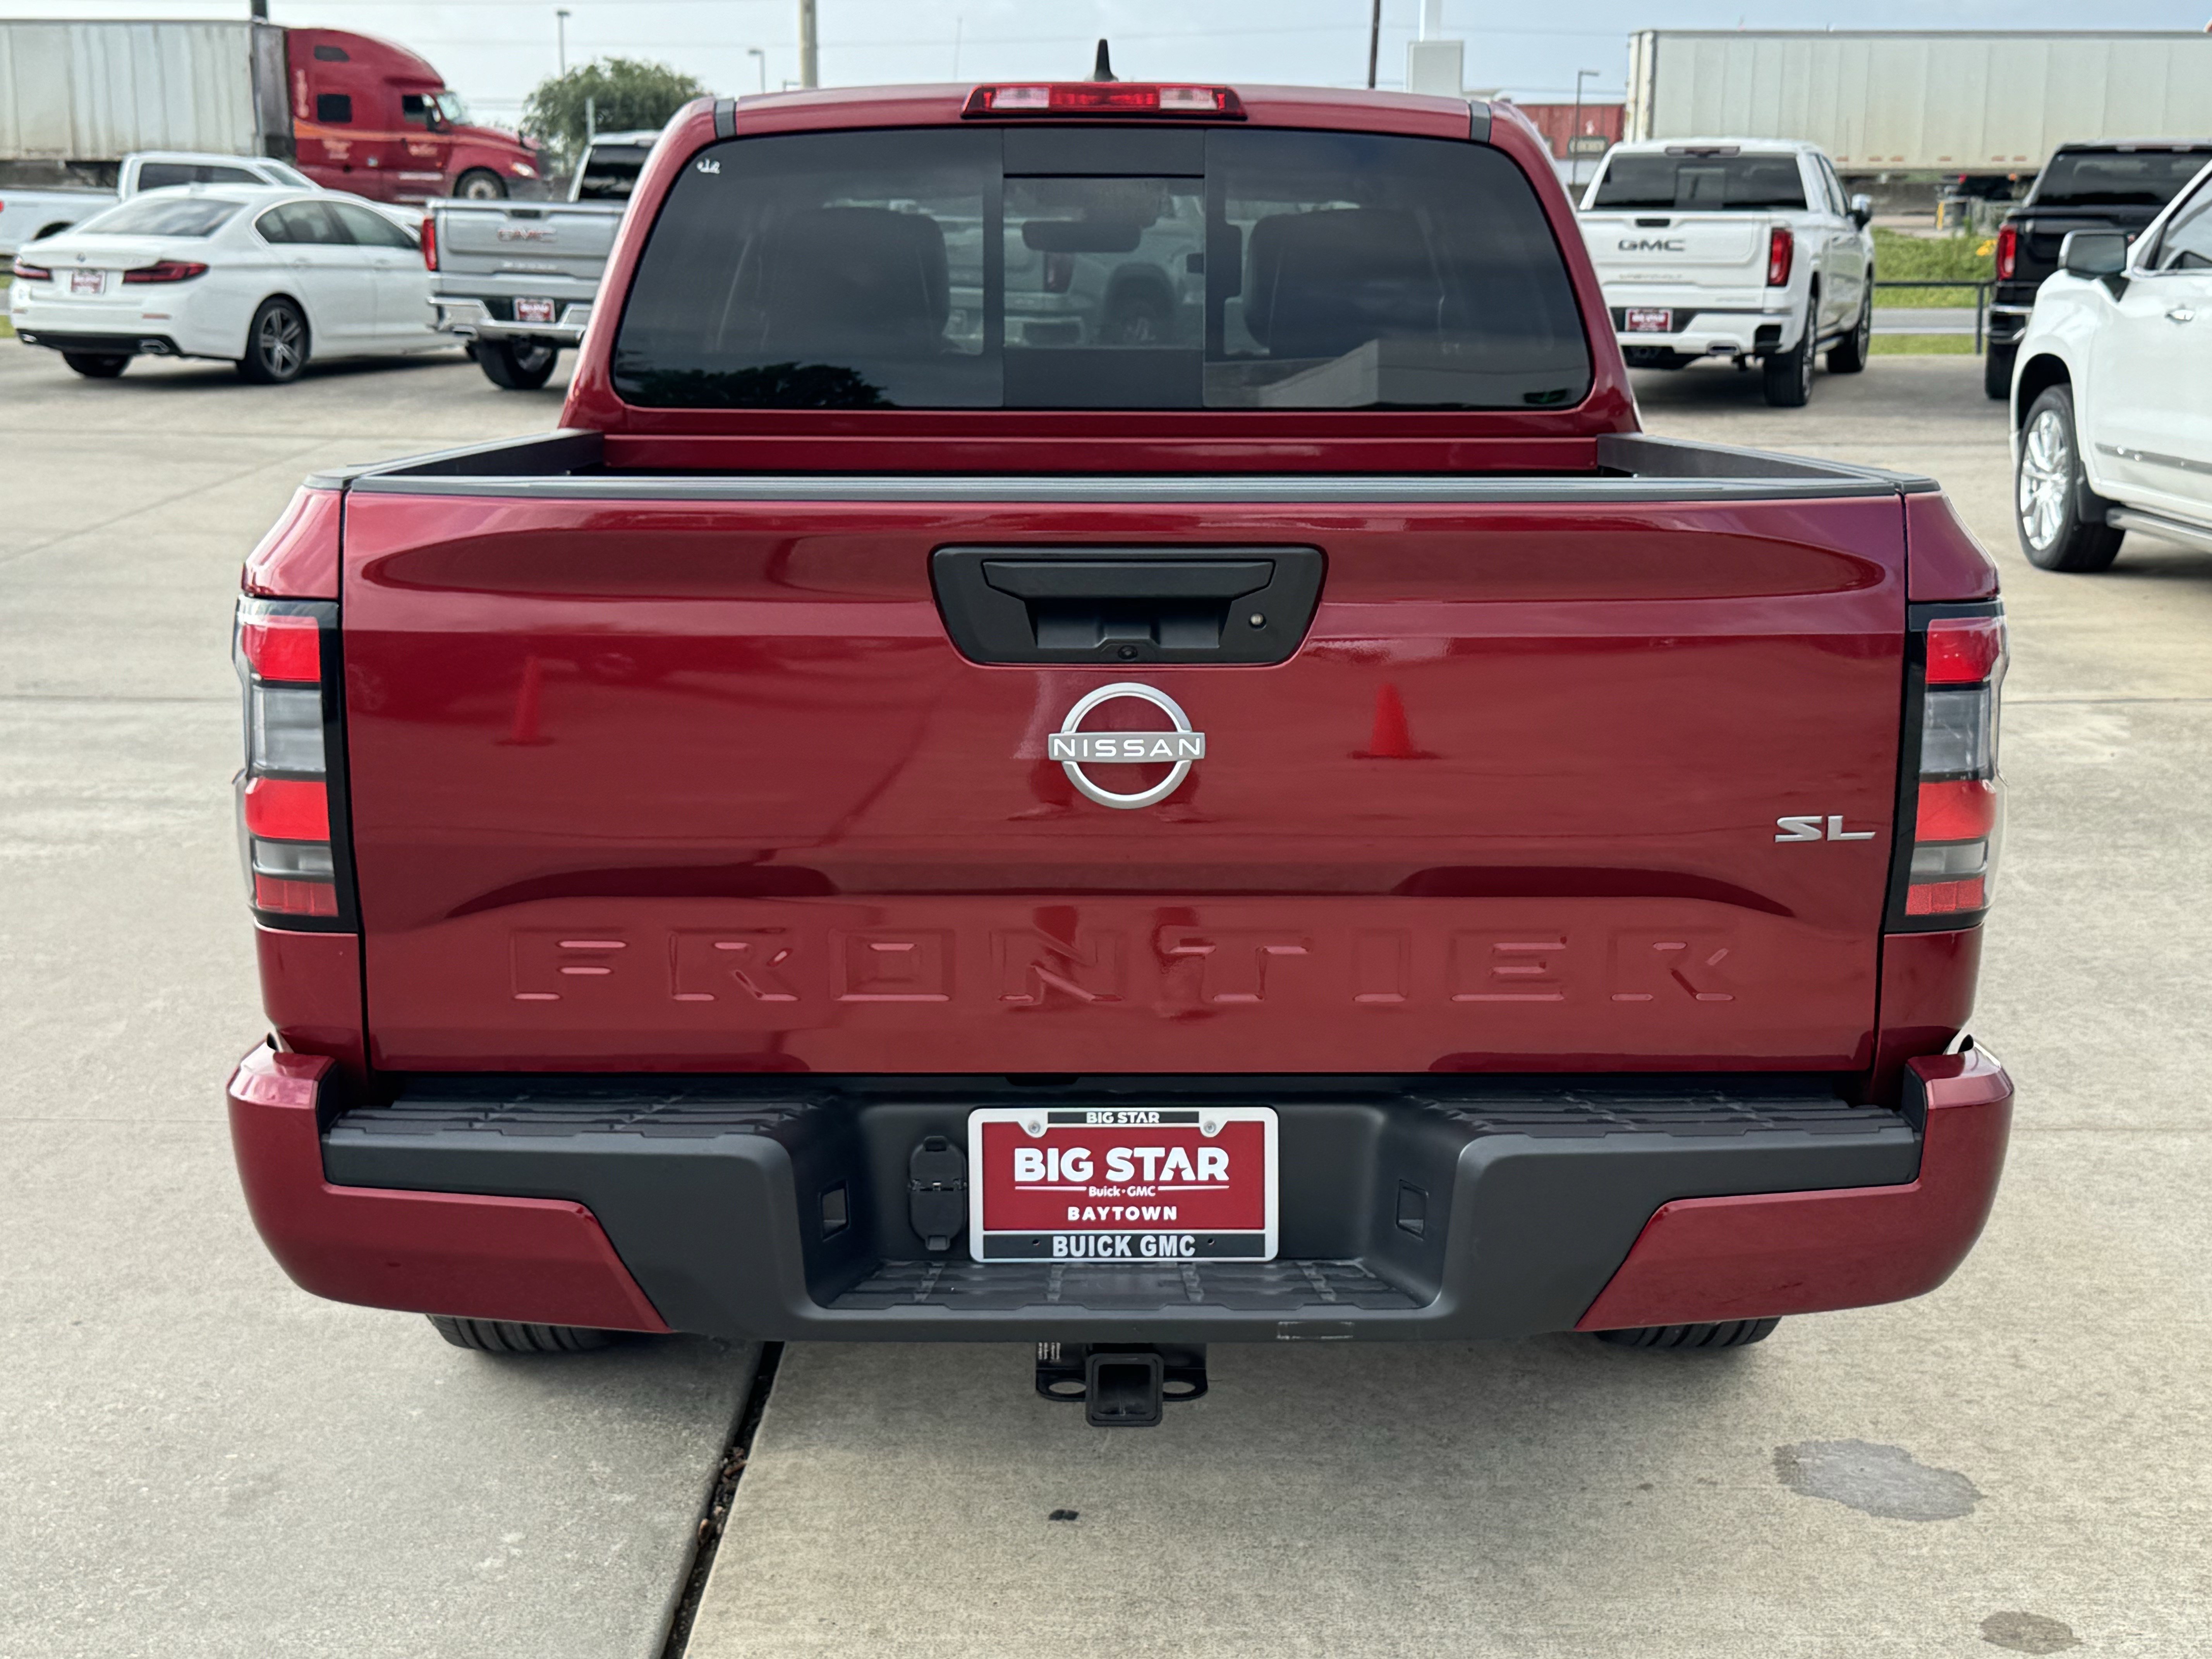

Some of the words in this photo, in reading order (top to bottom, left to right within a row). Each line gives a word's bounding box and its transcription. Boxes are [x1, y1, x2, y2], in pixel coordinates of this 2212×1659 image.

[1618, 239, 1685, 252] GMC
[1054, 738, 1200, 757] NISSAN
[1775, 816, 1876, 842] SL
[508, 927, 1736, 1001] FRONTIER
[1086, 1112, 1114, 1123] BIG
[1117, 1112, 1160, 1123] STAR
[1015, 1147, 1093, 1182] BIG
[1106, 1147, 1230, 1182] STAR
[1068, 1206, 1177, 1221] BAYTOWN
[1053, 1235, 1132, 1257] BUICK
[1140, 1235, 1196, 1257] GMC
